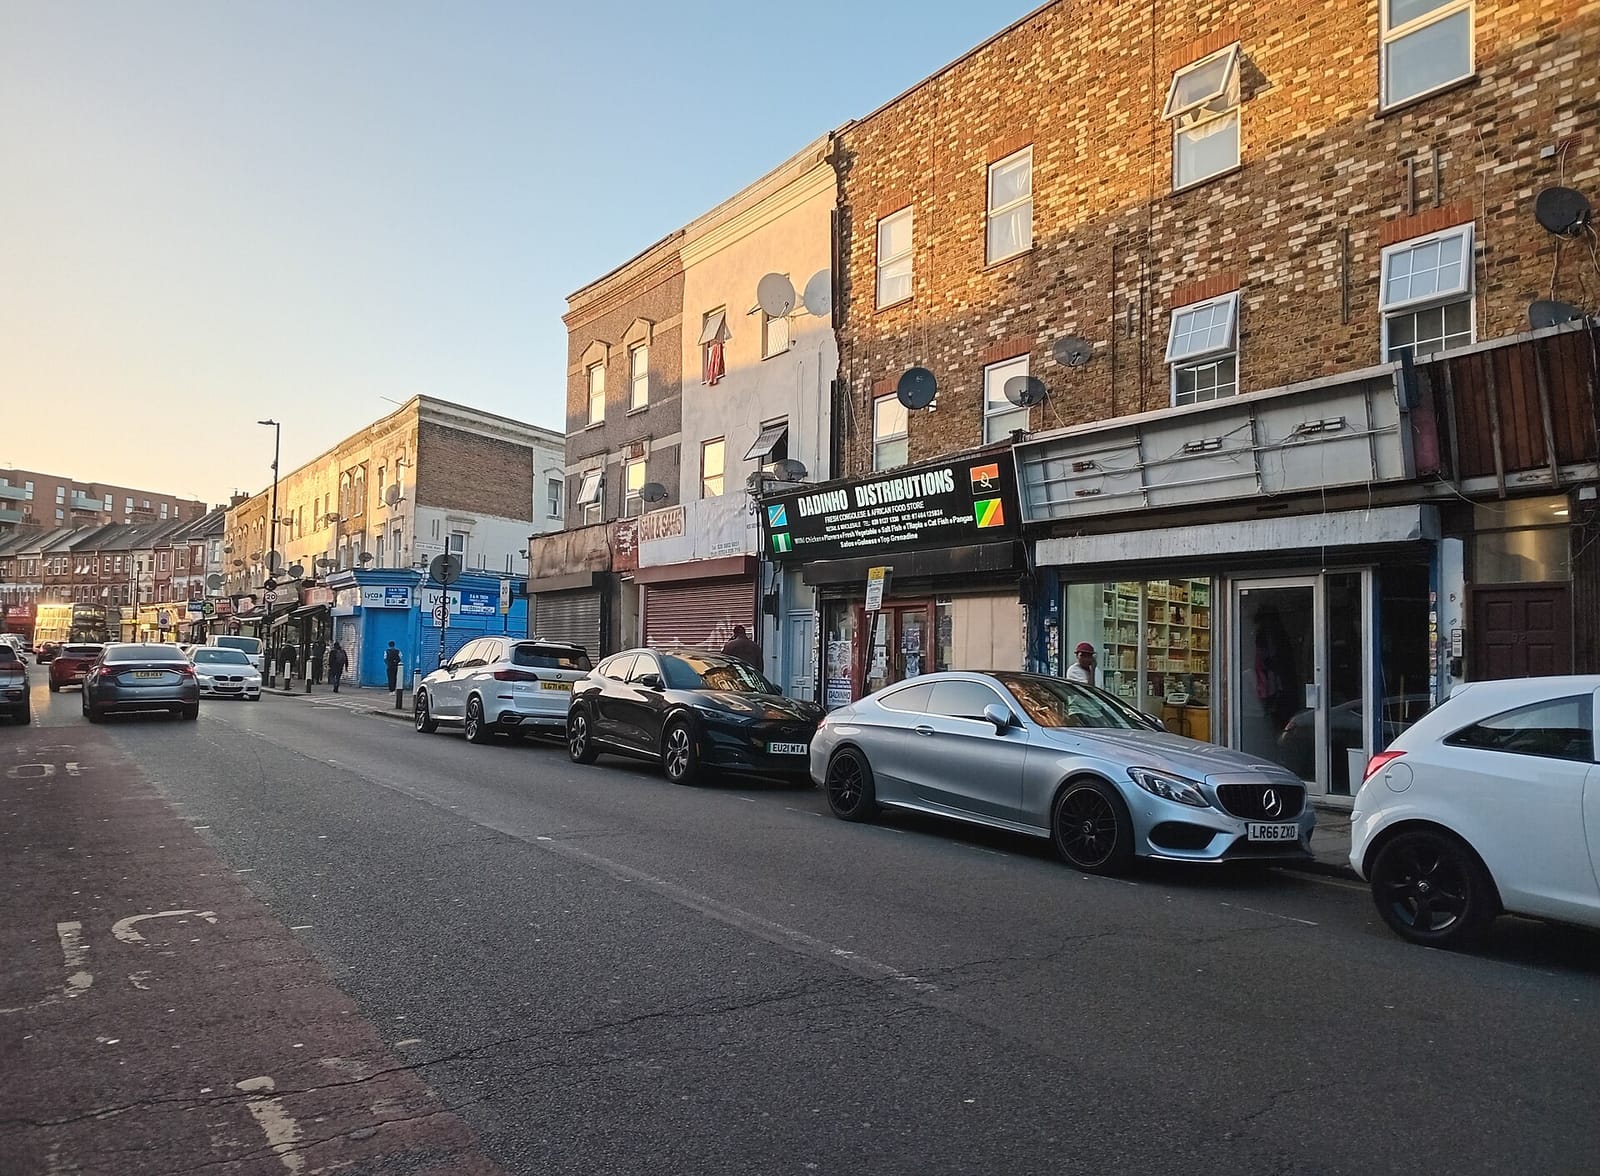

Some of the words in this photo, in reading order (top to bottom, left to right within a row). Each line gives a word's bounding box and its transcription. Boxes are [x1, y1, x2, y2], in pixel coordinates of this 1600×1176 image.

[798, 489, 849, 517] DADINHO
[854, 468, 955, 508] DISTRIBUTIONS
[824, 515, 839, 524] FRESH
[871, 506, 892, 516] AFRICAN
[892, 503, 907, 513] FOOD
[906, 500, 925, 511] STORE
[891, 523, 903, 532] Fish
[937, 516, 950, 525] Fish
[364, 591, 379, 599] Lyca
[772, 743, 789, 753] EU21
[1252, 825, 1279, 840] LR66
